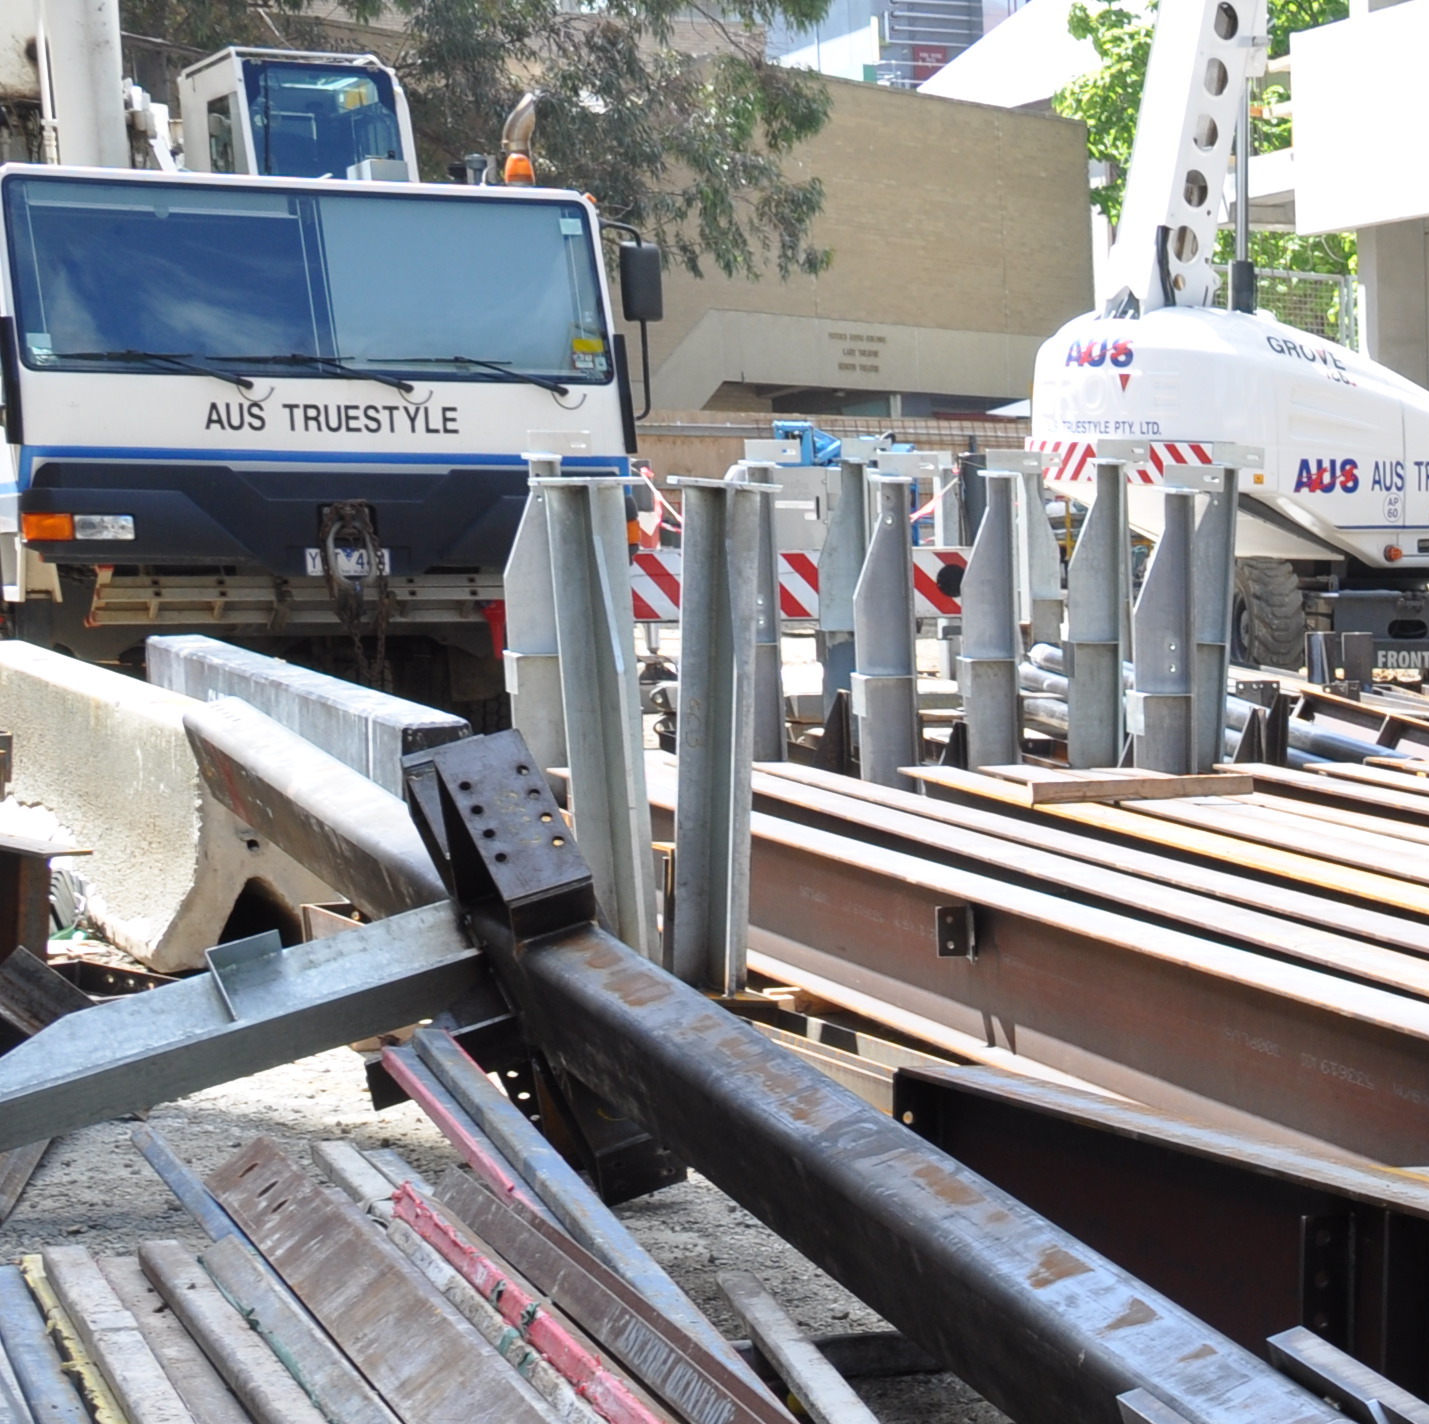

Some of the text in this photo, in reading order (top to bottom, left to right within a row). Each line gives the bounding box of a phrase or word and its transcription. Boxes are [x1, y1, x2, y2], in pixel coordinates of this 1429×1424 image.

[1065, 337, 1134, 367] AUS
[1266, 335, 1346, 371] GROVE
[205, 401, 459, 433] AUS TRUESTYLE
[1140, 421, 1162, 435] LTD.
[1293, 458, 1359, 493] AUS
[1371, 460, 1405, 492] AUS
[1388, 509, 1399, 518] 60
